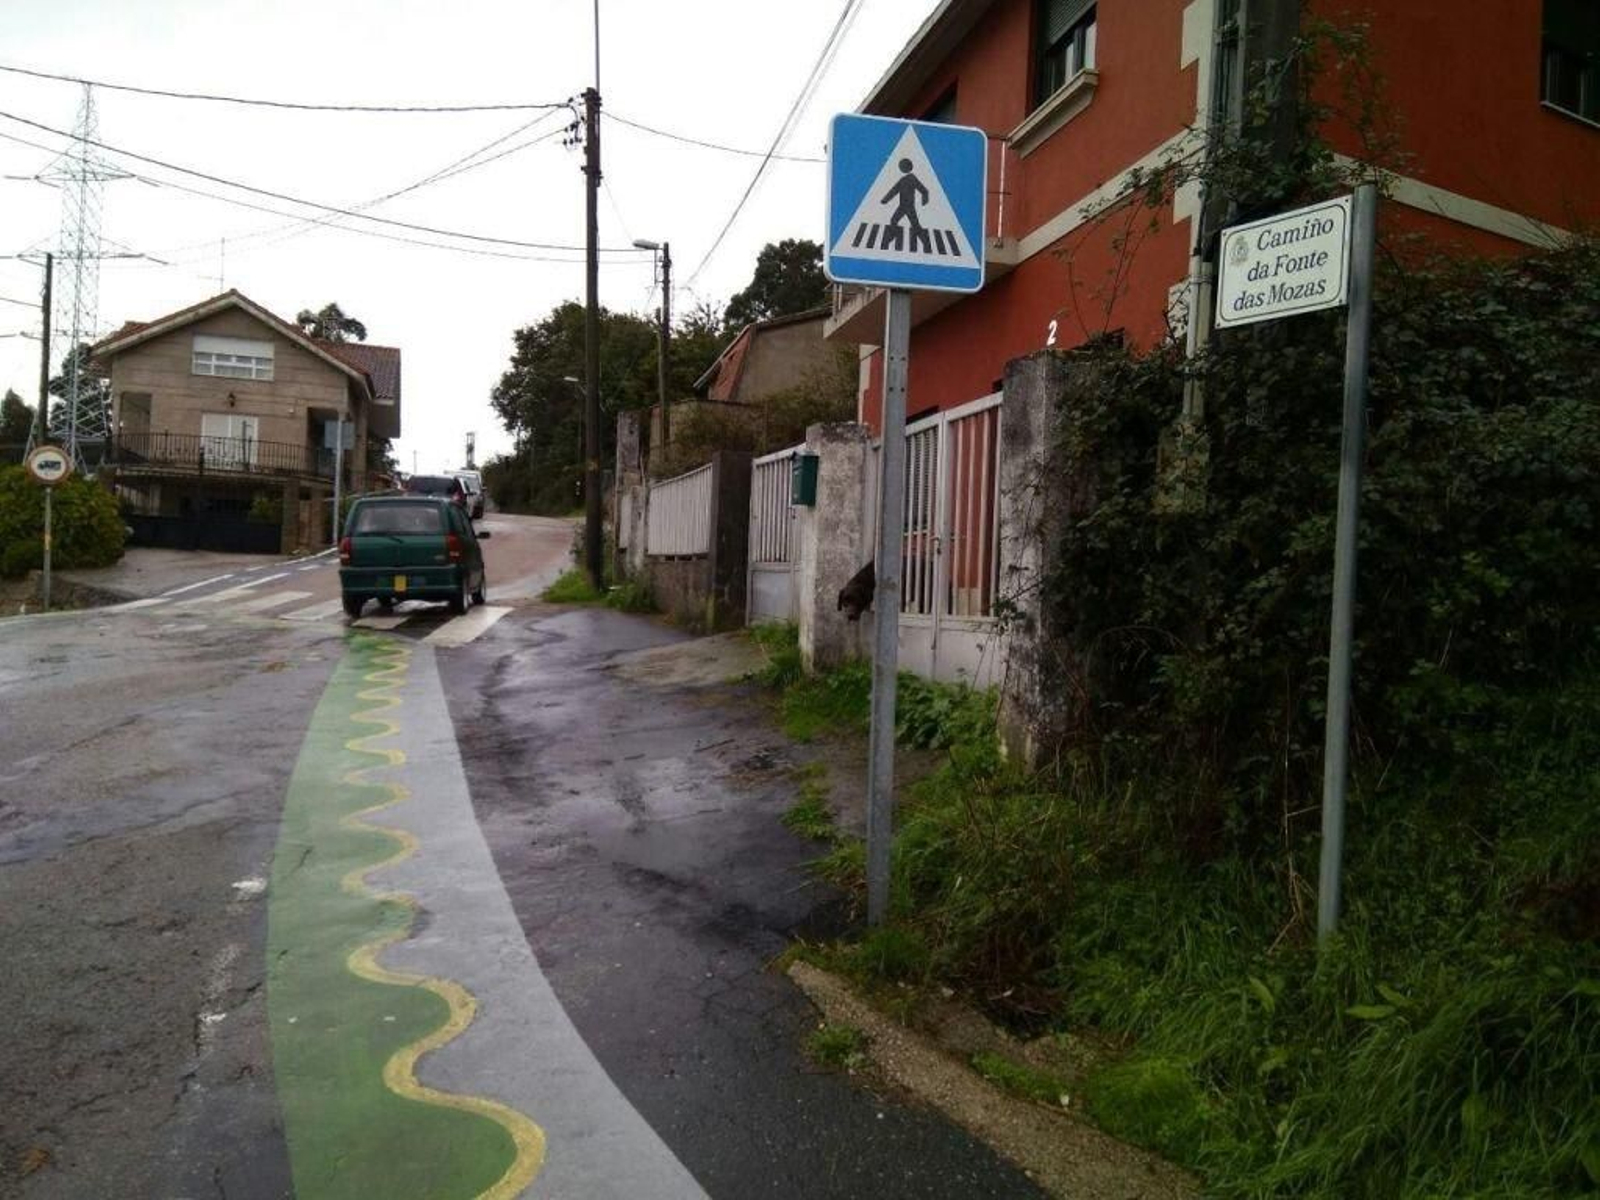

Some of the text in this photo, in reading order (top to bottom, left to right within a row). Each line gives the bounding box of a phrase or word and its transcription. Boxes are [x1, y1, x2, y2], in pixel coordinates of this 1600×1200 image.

[1257, 218, 1334, 251] Camiño
[1247, 250, 1328, 282] da Fonte
[1233, 279, 1327, 312] das Mozas
[1046, 319, 1058, 346] 2
